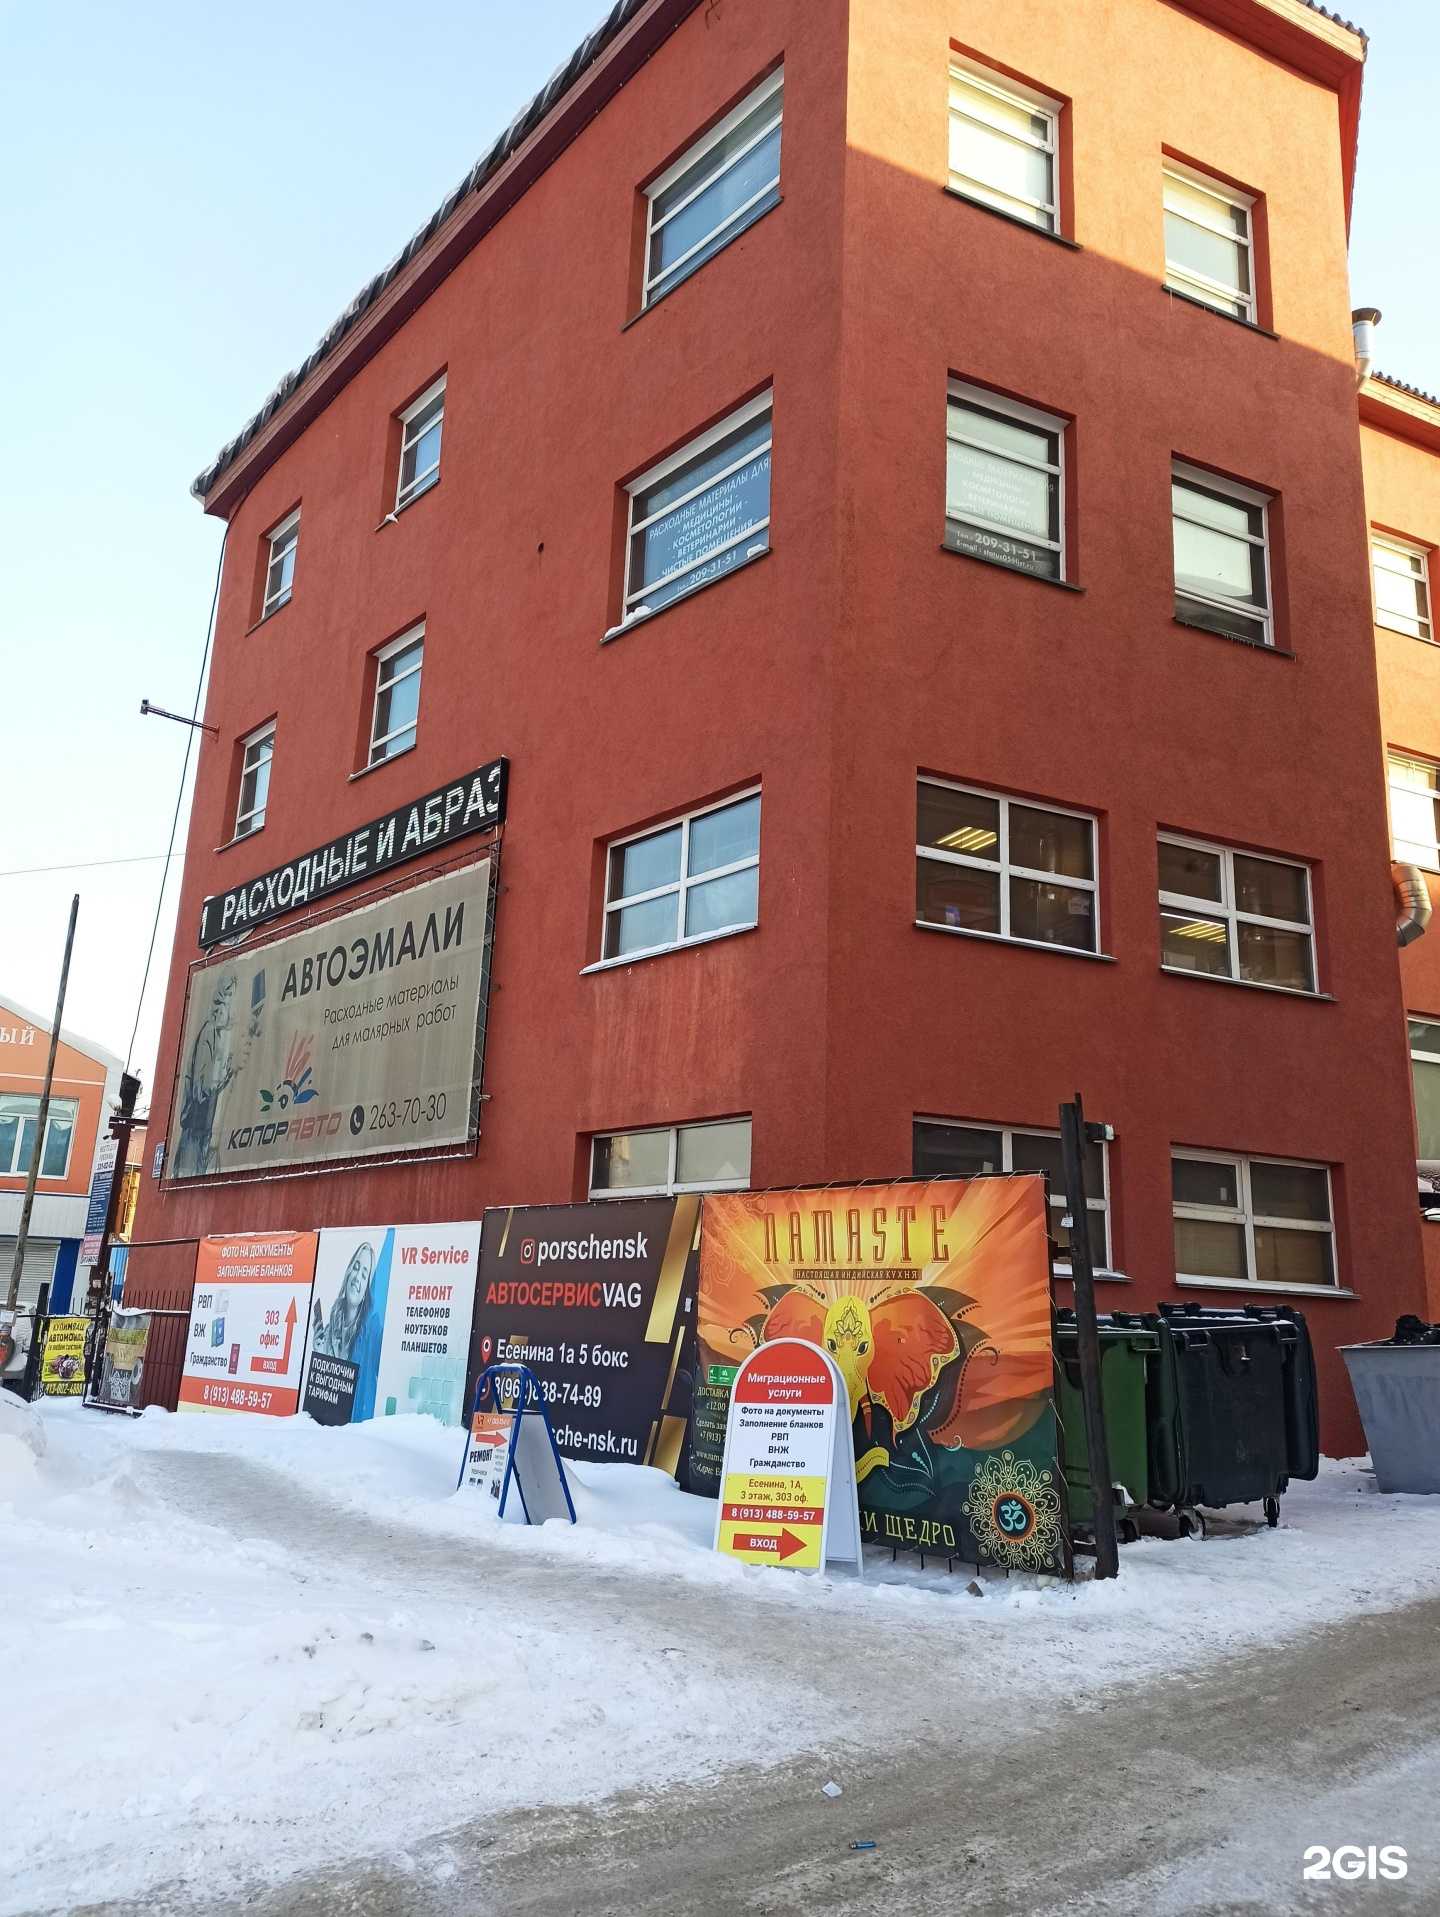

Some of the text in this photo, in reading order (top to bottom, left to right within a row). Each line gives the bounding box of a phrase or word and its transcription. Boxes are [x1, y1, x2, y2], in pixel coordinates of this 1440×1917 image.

[699, 472, 749, 509] МАТЕРИАЛЫ
[975, 532, 1037, 562] 209-31-51
[690, 550, 737, 583] 209-31-51
[221, 829, 370, 930] РАСХОДНЫЕ
[281, 902, 464, 1001] АВТОЭМАЛИ
[324, 974, 459, 1024] Расходные материалы
[332, 1003, 457, 1050] для малярных работ
[369, 1092, 447, 1130] 263-70-30
[764, 1205, 950, 1264] NAMASTE
[222, 1243, 294, 1260] ФОТО НА ДОКУМЕНТЫ
[401, 1245, 469, 1264] VR Service
[538, 1232, 648, 1266] porschensk
[217, 1263, 293, 1278] ЗАПОЛНЕНИЕ БЛАНКОВ
[796, 1270, 917, 1280] НАСТОЯЩАЯ ИНДИЙСКАЯ КУХНЯ
[408, 1286, 453, 1301] РЕМОНТ
[198, 1294, 213, 1309] РВП
[265, 1310, 280, 1325] 303
[406, 1306, 450, 1319] ТЕЛЕФОНОВ
[404, 1324, 448, 1337] НОУТБУКОВ
[259, 1330, 279, 1349] офис
[401, 1341, 447, 1354] ПЛАНШЕТОВ
[496, 1339, 629, 1368] Есенина 1а 5 бокс
[190, 1352, 228, 1368] Гражданство
[312, 1357, 355, 1380] ПОДКЛЮЧИМ
[315, 1372, 354, 1395] ВЫГОДНЫМ
[748, 1373, 826, 1385] Миграционные
[203, 1385, 273, 1409] 8 (913) 488-59-57
[308, 1385, 338, 1405] ТАРИФАМ
[697, 1386, 729, 1399] ДОСТАВКА
[768, 1389, 802, 1399] услуги
[741, 1406, 763, 1415] Фото
[776, 1408, 824, 1417] документы
[739, 1419, 824, 1429] Заполнение бланков
[771, 1432, 789, 1441] РВП
[469, 1449, 493, 1463] РЕМОНТ
[768, 1445, 789, 1454] ВНЖ
[749, 1458, 806, 1468] Гражданство
[749, 1479, 803, 1490] Есенина, 1А,
[740, 1491, 809, 1504] 3 этаж, 303 оф.
[731, 1508, 816, 1521] 8 (913) 488-59-57
[885, 1513, 956, 1547] ЩЕДРО
